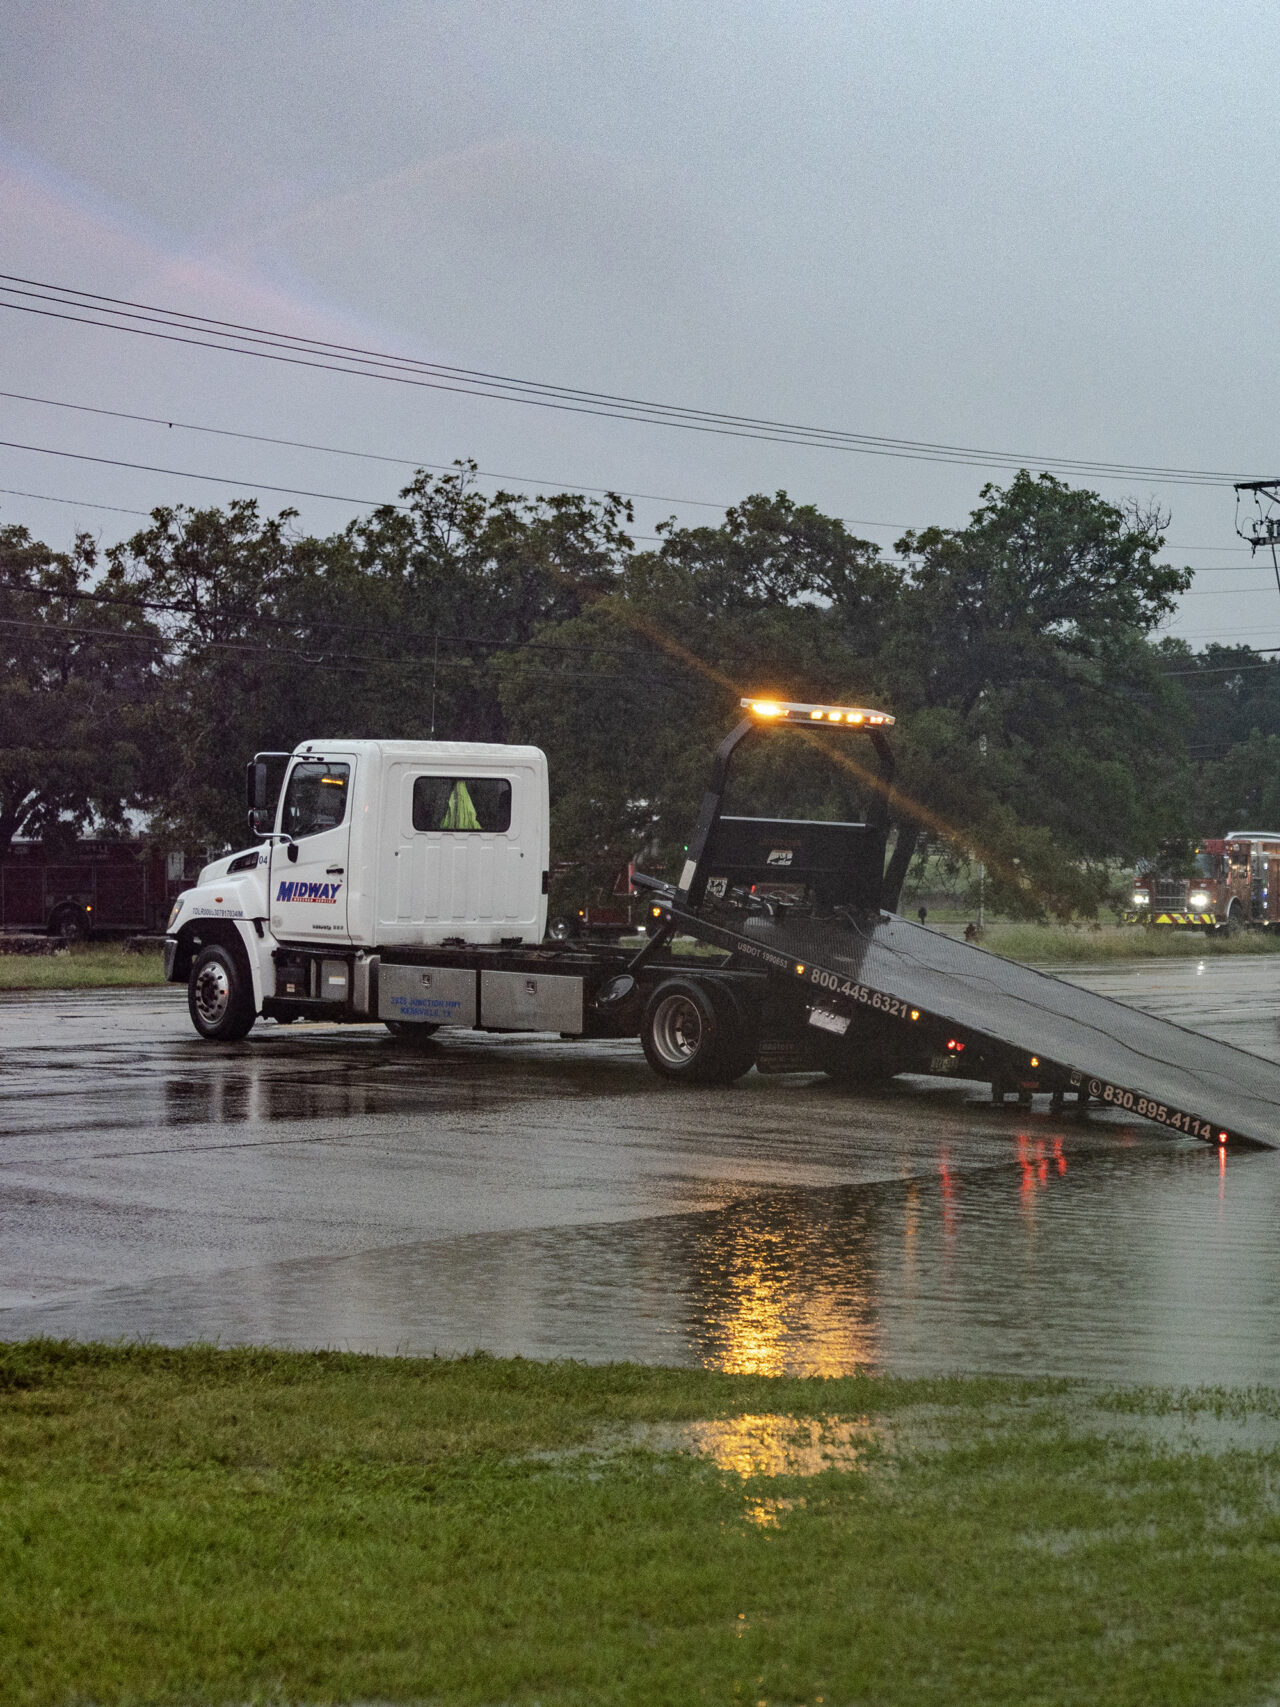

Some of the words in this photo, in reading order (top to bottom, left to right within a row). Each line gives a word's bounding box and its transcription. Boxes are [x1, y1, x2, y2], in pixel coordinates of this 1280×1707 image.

[258, 855, 268, 865] 04
[276, 880, 343, 903] MIDWAY
[737, 942, 760, 957] USDOT
[811, 968, 908, 1019] 800.445.6321
[1103, 1085, 1212, 1140] 830.895.4114
